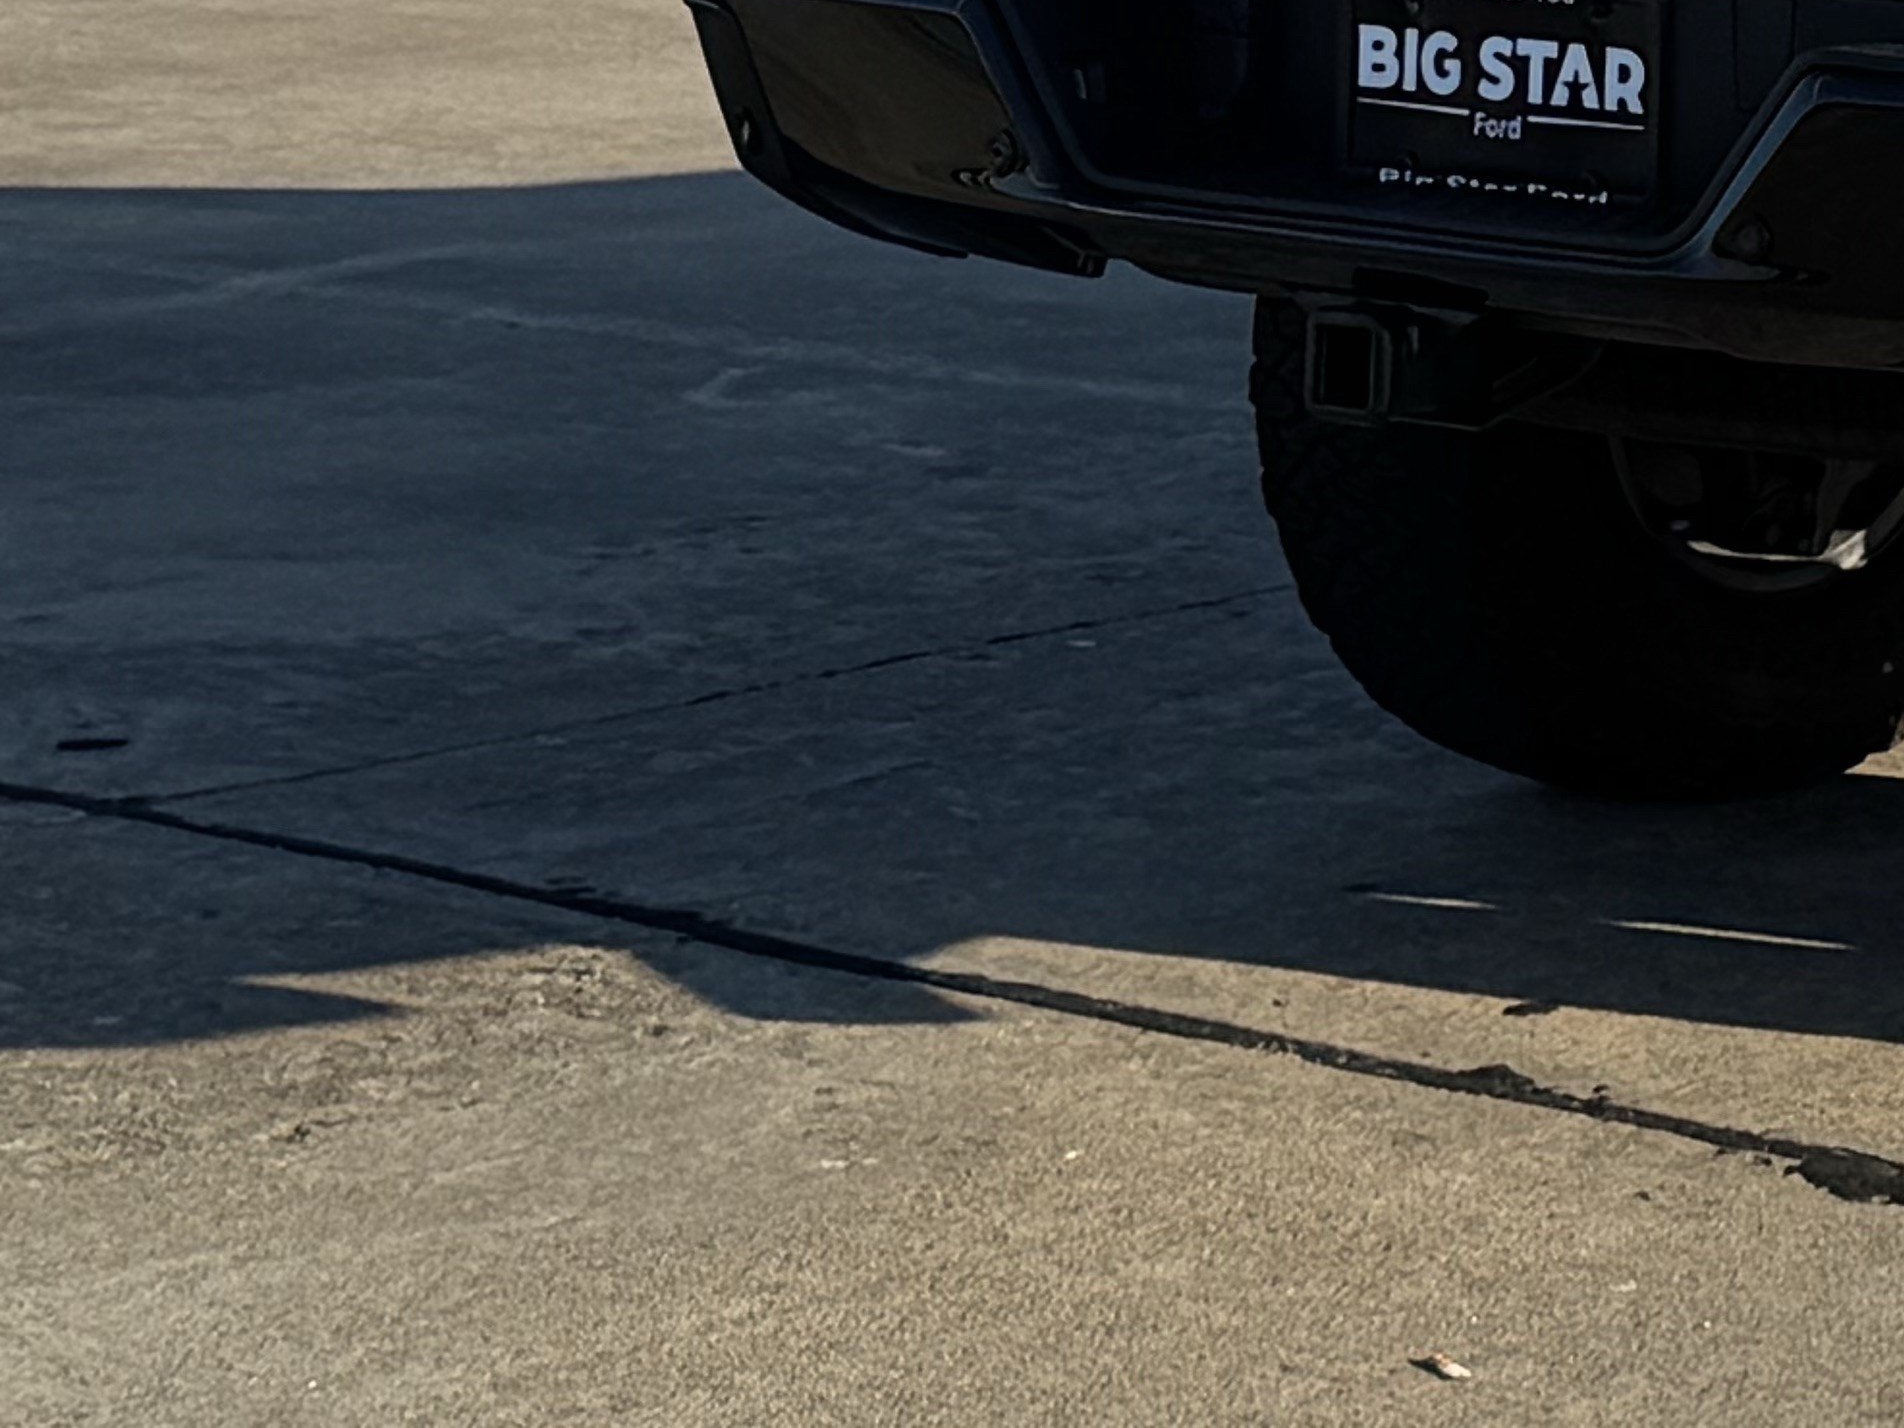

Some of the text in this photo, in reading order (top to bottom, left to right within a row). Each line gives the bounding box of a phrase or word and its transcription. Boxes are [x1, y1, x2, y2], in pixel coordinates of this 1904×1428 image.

[1357, 23, 1645, 115] BIG STAR
[1473, 111, 1522, 140] Ford
